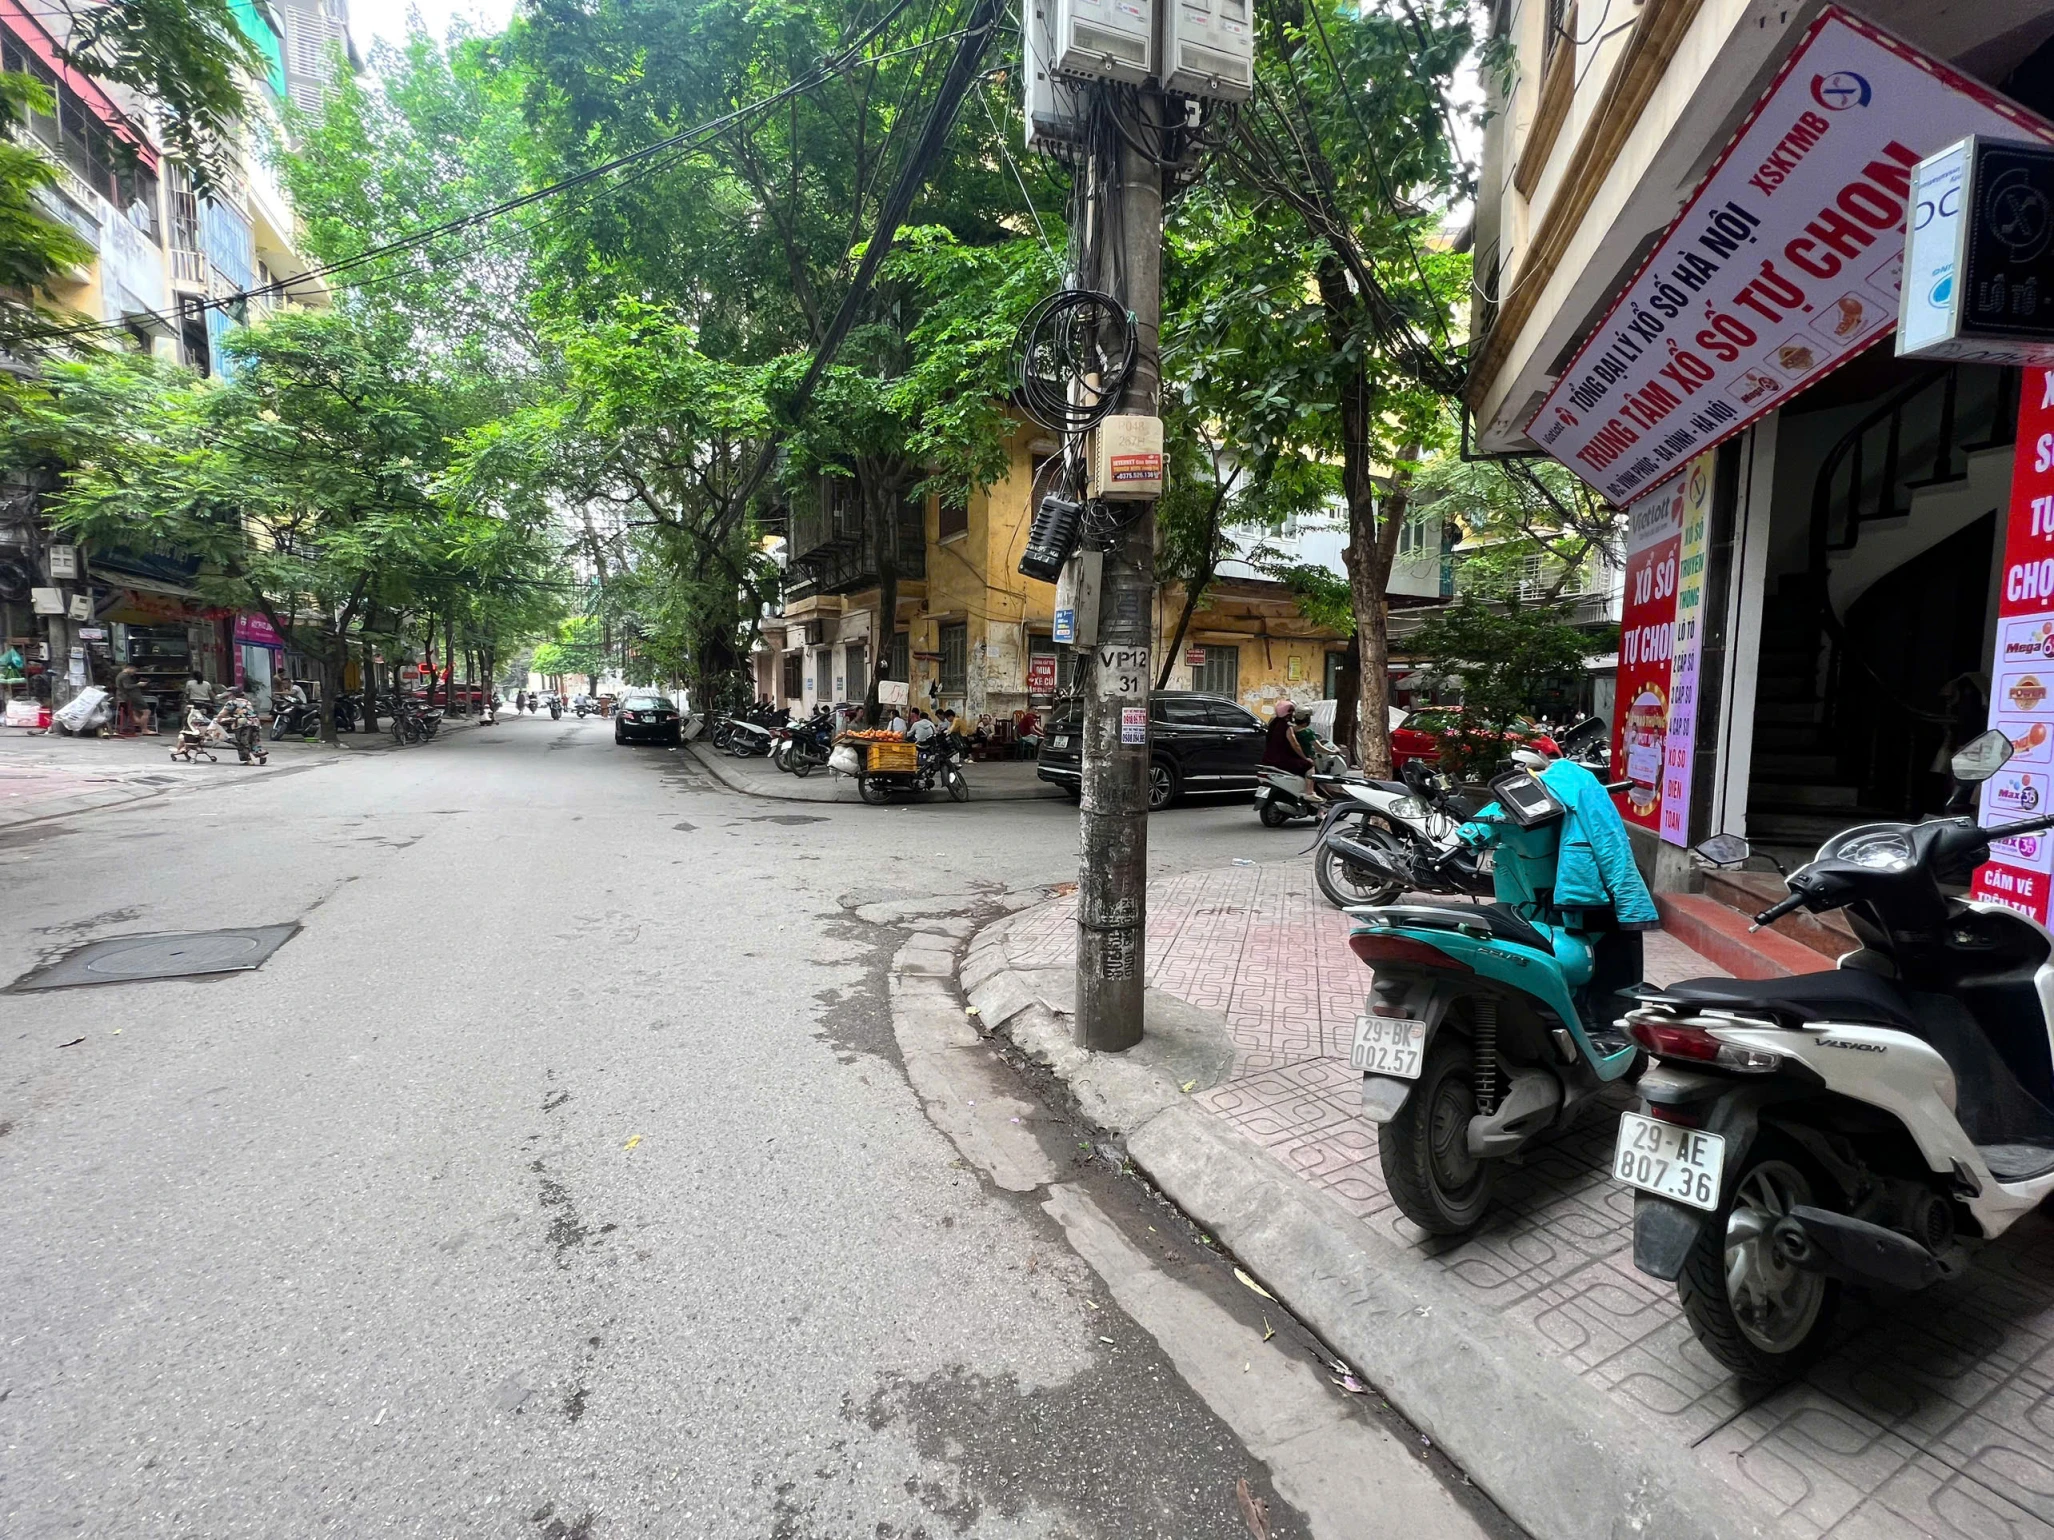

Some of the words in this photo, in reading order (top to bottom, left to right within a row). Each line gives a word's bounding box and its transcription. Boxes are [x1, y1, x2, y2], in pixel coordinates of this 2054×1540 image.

[1747, 110, 1830, 197] XSKTMB
[1698, 201, 1761, 260] NỘI
[1671, 250, 1720, 293] HÀ
[1650, 273, 1689, 319] SỐ
[1627, 302, 1665, 344] XỔ
[1576, 418, 1640, 472] TRUNG
[1618, 379, 1682, 430] TÂM
[1659, 338, 1715, 395] XỔ
[1695, 298, 1758, 363] SỐ
[1732, 258, 1815, 324] TỰ
[1612, 331, 1644, 363] LÝ
[1592, 352, 1629, 385] ĐẠI
[1568, 375, 1609, 413] TỔNG
[1652, 444, 1677, 462] BA
[1690, 413, 1717, 435] HÀ
[1707, 399, 1739, 424] NỘI
[1632, 495, 1671, 535] Vietlott
[1633, 551, 1655, 607] XỔ
[1654, 542, 1677, 600] SỐ
[1100, 650, 1147, 669] VP12
[1623, 624, 1641, 672] TỰ
[2005, 642, 2042, 655] Mega
[1033, 677, 1043, 686] XE
[1036, 665, 1051, 675] MUA
[1119, 675, 1138, 693] 31
[1998, 788, 2020, 800] Max
[1984, 867, 2013, 892] CẦM
[2016, 877, 2034, 897] VÉ
[1362, 1019, 1414, 1047] 29-BK
[1812, 1037, 1888, 1053] VISION
[1354, 1043, 1418, 1074] 002.57
[1632, 1121, 1708, 1167] 29-AE
[1620, 1150, 1712, 1203] 807.36
